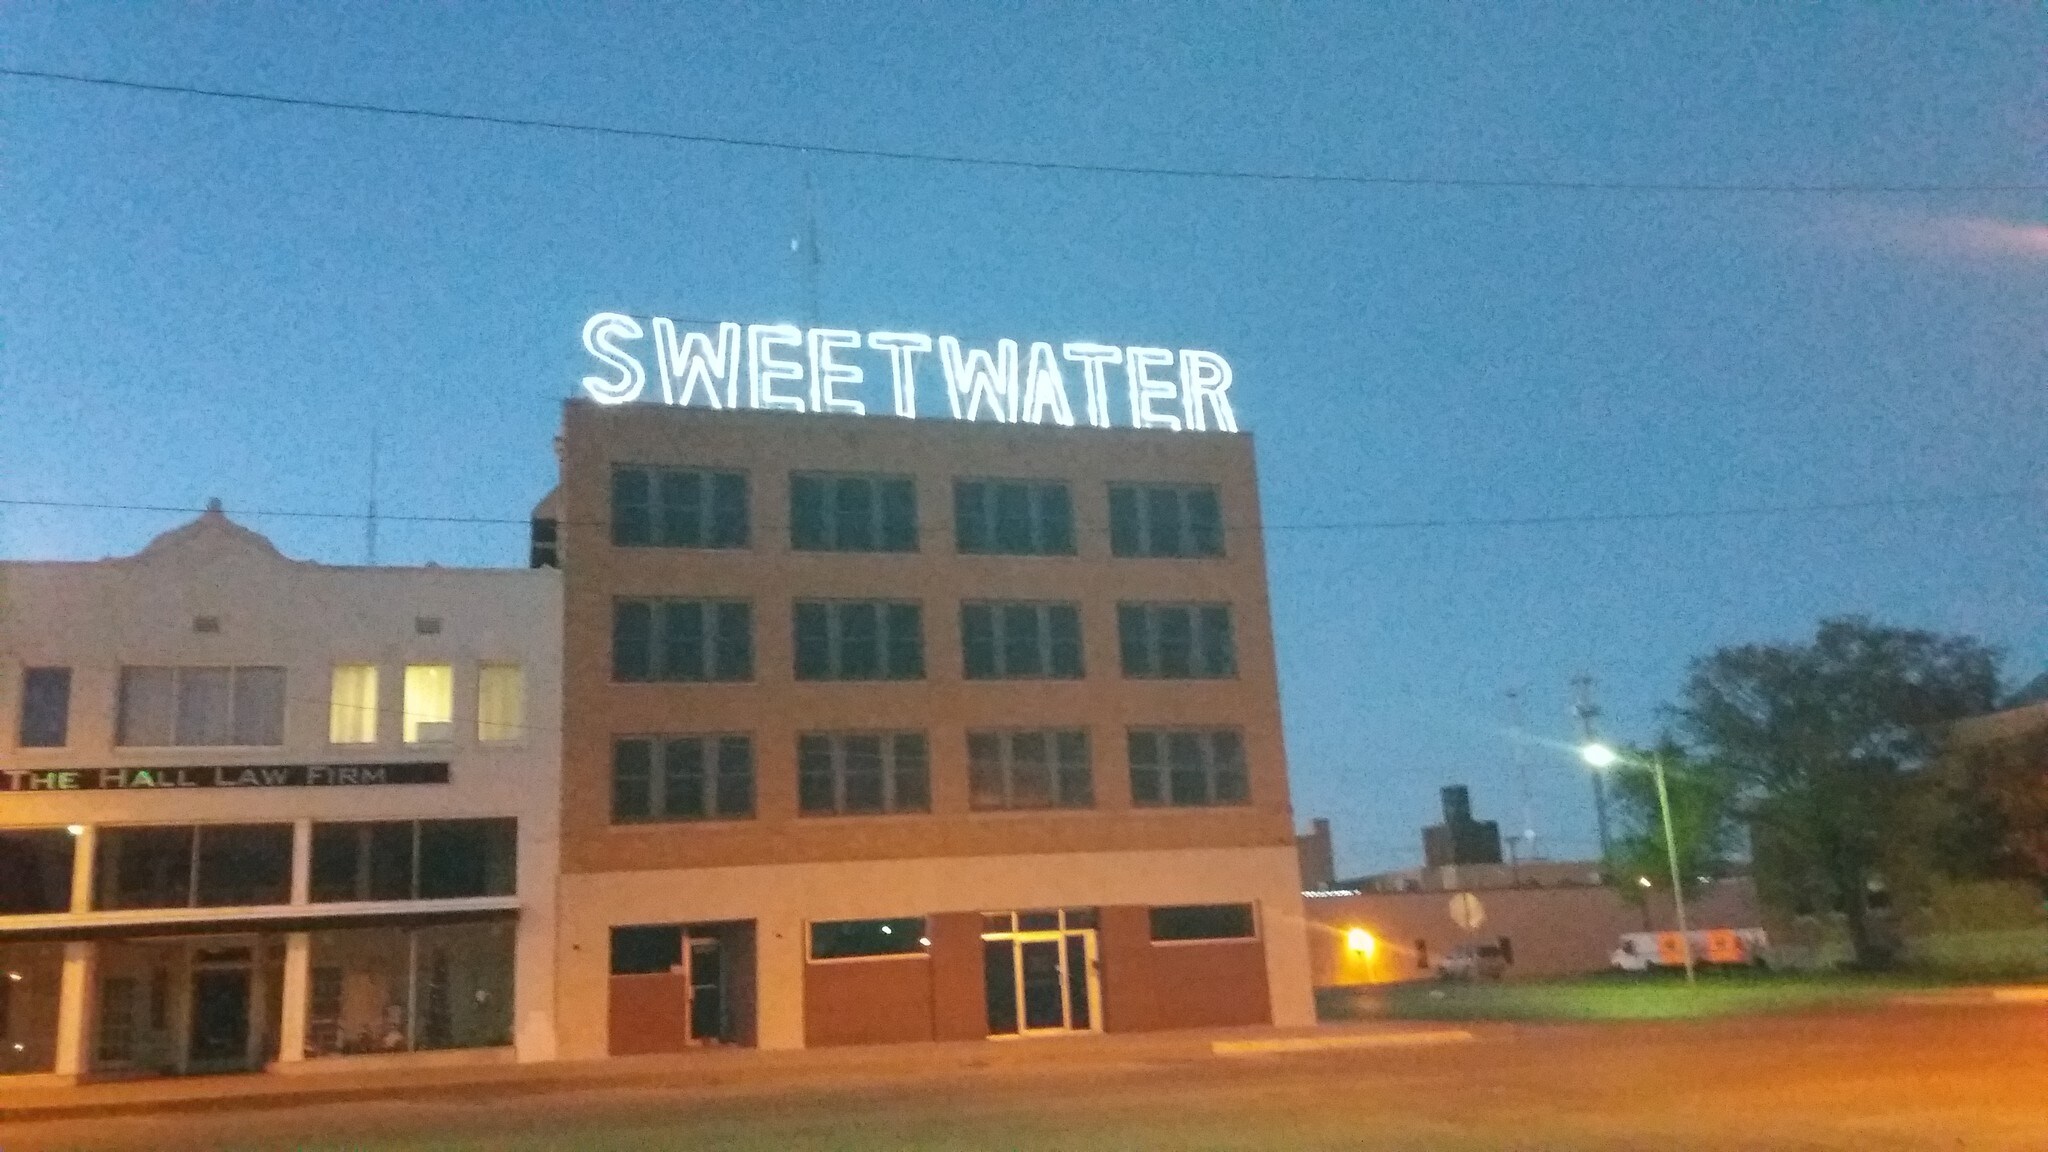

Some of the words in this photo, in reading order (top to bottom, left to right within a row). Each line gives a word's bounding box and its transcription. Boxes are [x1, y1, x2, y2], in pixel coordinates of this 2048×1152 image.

[582, 312, 1239, 433] SWEETWATER
[6, 769, 80, 790] THE
[101, 768, 196, 789] HALL
[214, 766, 289, 787] LAW
[305, 764, 388, 785] FIRM
